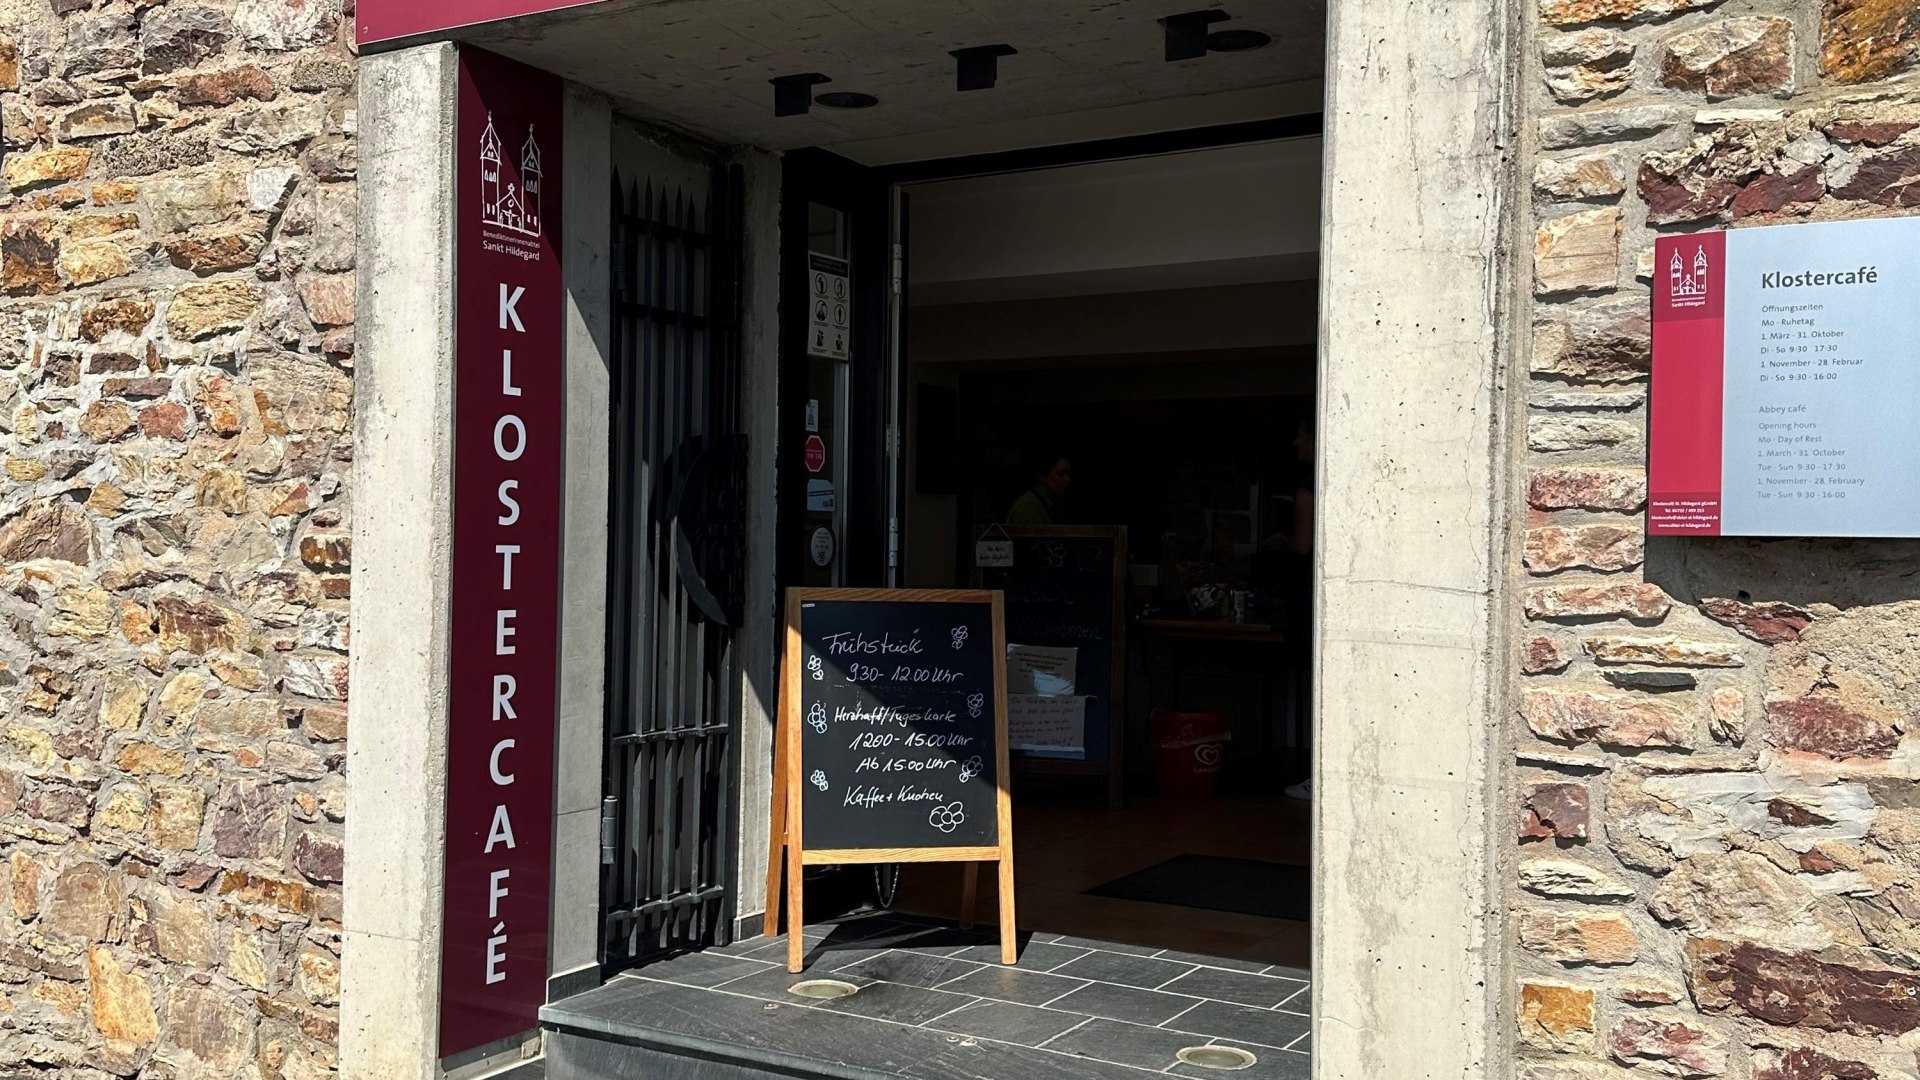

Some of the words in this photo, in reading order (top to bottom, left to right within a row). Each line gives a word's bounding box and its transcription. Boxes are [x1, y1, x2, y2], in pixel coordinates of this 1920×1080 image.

[482, 240, 504, 253] Sankt
[505, 245, 540, 261] Hildegard
[1762, 266, 1878, 289] Klostercafé
[1761, 303, 1824, 313] Öffnungszeiten
[1781, 317, 1815, 326] Ruhetag
[1770, 332, 1790, 340] März
[1811, 330, 1845, 338] Oktober
[1769, 360, 1811, 368] November
[1832, 358, 1864, 366] Februar
[1758, 405, 1786, 415] Abbey
[1788, 404, 1806, 413] café
[1758, 422, 1792, 431] Opening
[1793, 421, 1817, 429] hours
[1777, 436, 1794, 444] Day
[1795, 435, 1804, 443] of
[1805, 435, 1822, 443] Rest
[1766, 449, 1792, 457] March
[1766, 477, 1808, 485] November
[1828, 477, 1865, 486] February
[485, 283, 527, 985] KLOSTERCAFÉ
[931, 667, 964, 683] Uhr
[947, 732, 974, 746] Uhr
[855, 756, 879, 773] Ab
[925, 757, 957, 770] Uhr
[897, 785, 944, 801] Kuchen
